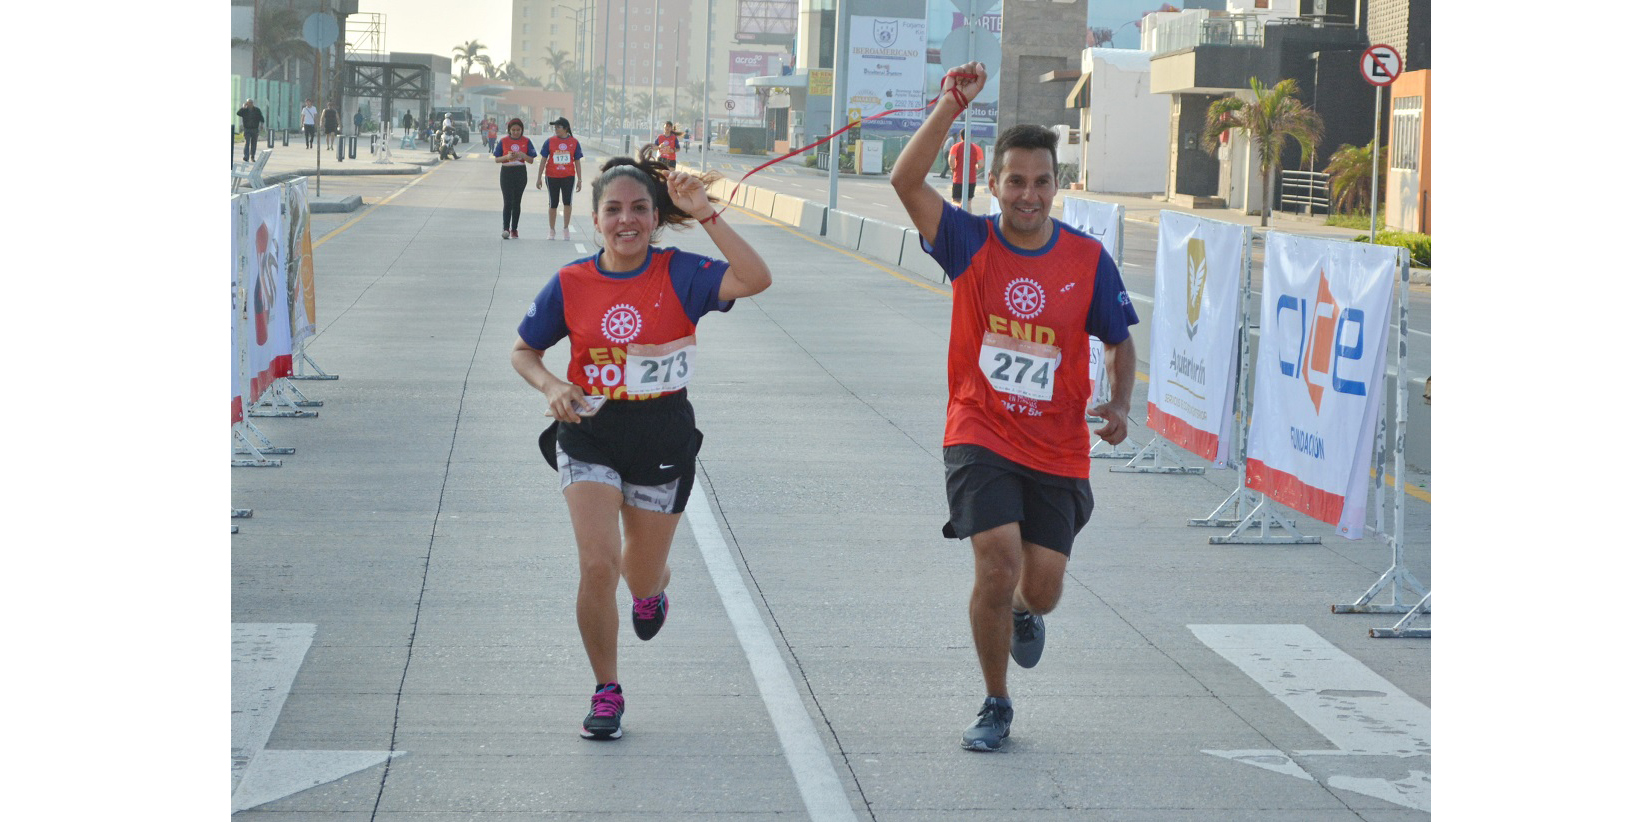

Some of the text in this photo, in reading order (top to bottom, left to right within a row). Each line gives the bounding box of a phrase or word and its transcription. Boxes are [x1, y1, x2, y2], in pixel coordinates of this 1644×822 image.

[852, 47, 919, 57] IBEROAMERICANO
[1372, 53, 1391, 77] E
[989, 313, 1056, 346] END
[640, 350, 689, 384] 273
[990, 352, 1049, 389] 274
[1290, 425, 1325, 460] FUNDACIÓN
